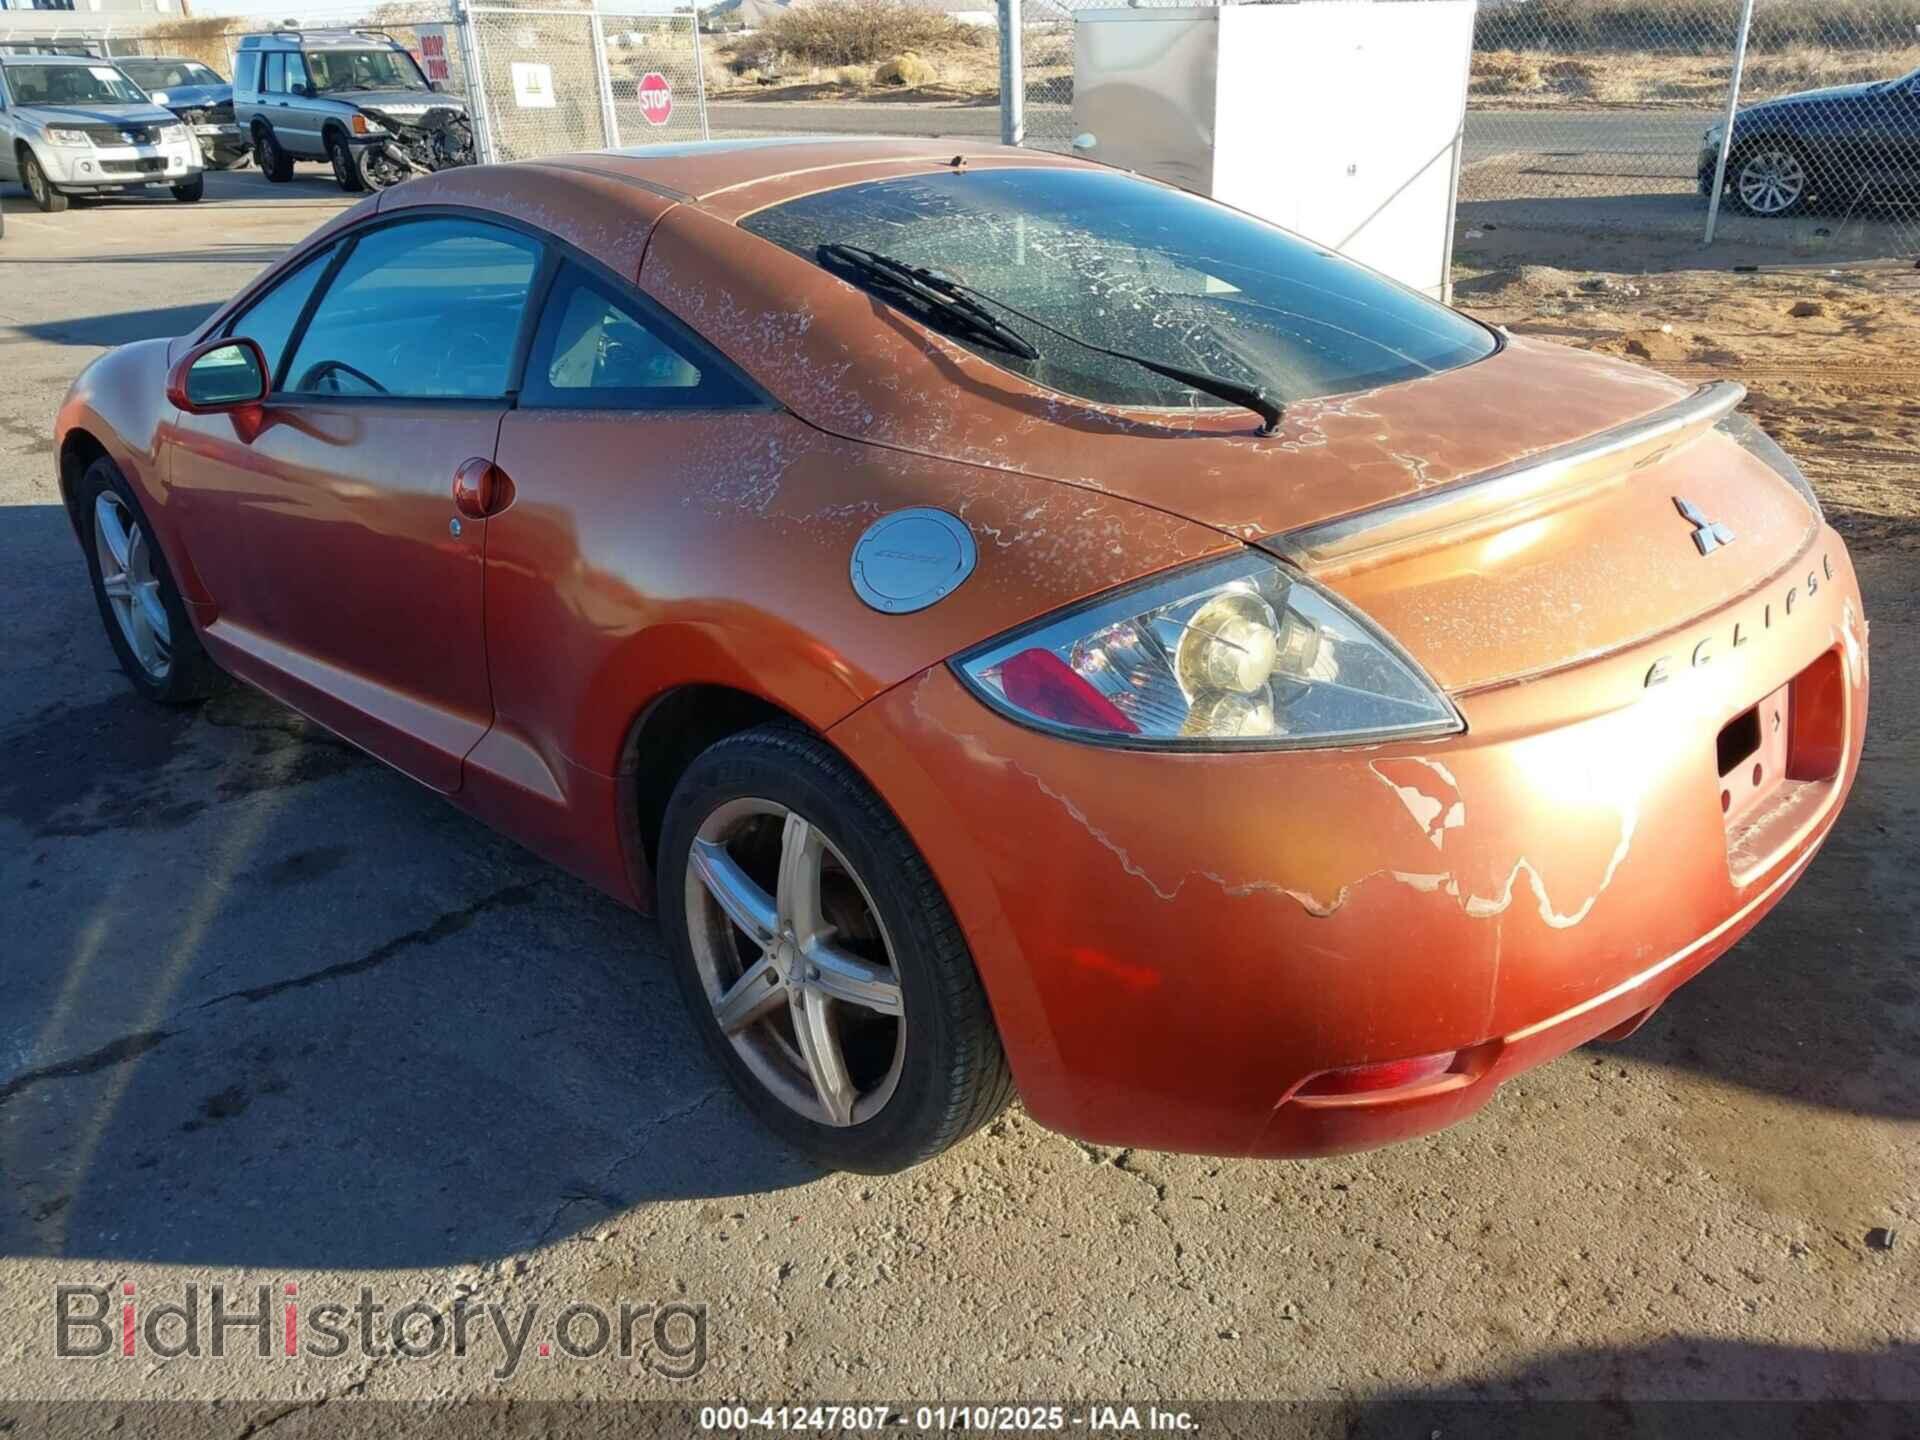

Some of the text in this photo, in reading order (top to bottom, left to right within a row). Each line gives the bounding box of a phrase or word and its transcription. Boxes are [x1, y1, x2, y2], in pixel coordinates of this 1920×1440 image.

[421, 35, 444, 56] DROP
[428, 60, 449, 79] ZONE
[640, 89, 669, 110] STOP
[1643, 553, 1835, 689] ECLIPSE
